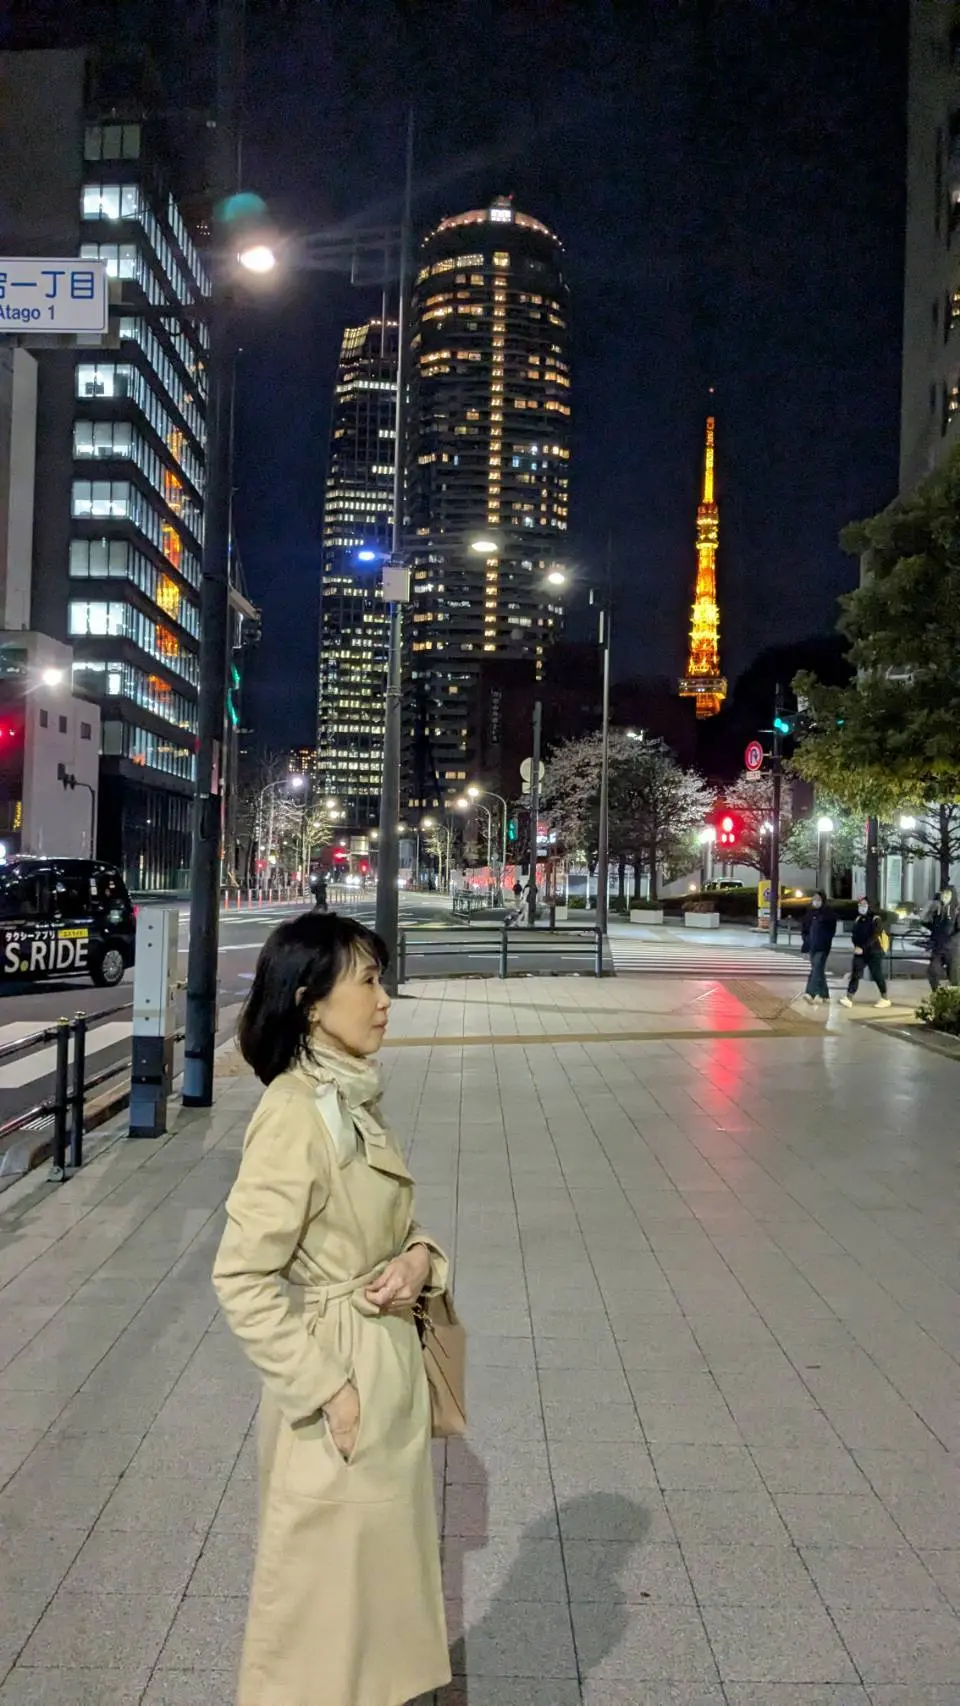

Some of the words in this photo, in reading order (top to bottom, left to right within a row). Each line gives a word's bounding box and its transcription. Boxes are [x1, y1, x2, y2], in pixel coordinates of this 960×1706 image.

[0, 271, 94, 299] 一丁目
[48, 304, 55, 320] 1
[5, 931, 55, 942] タクシーアプリ
[4, 938, 89, 973] S.RIDE
